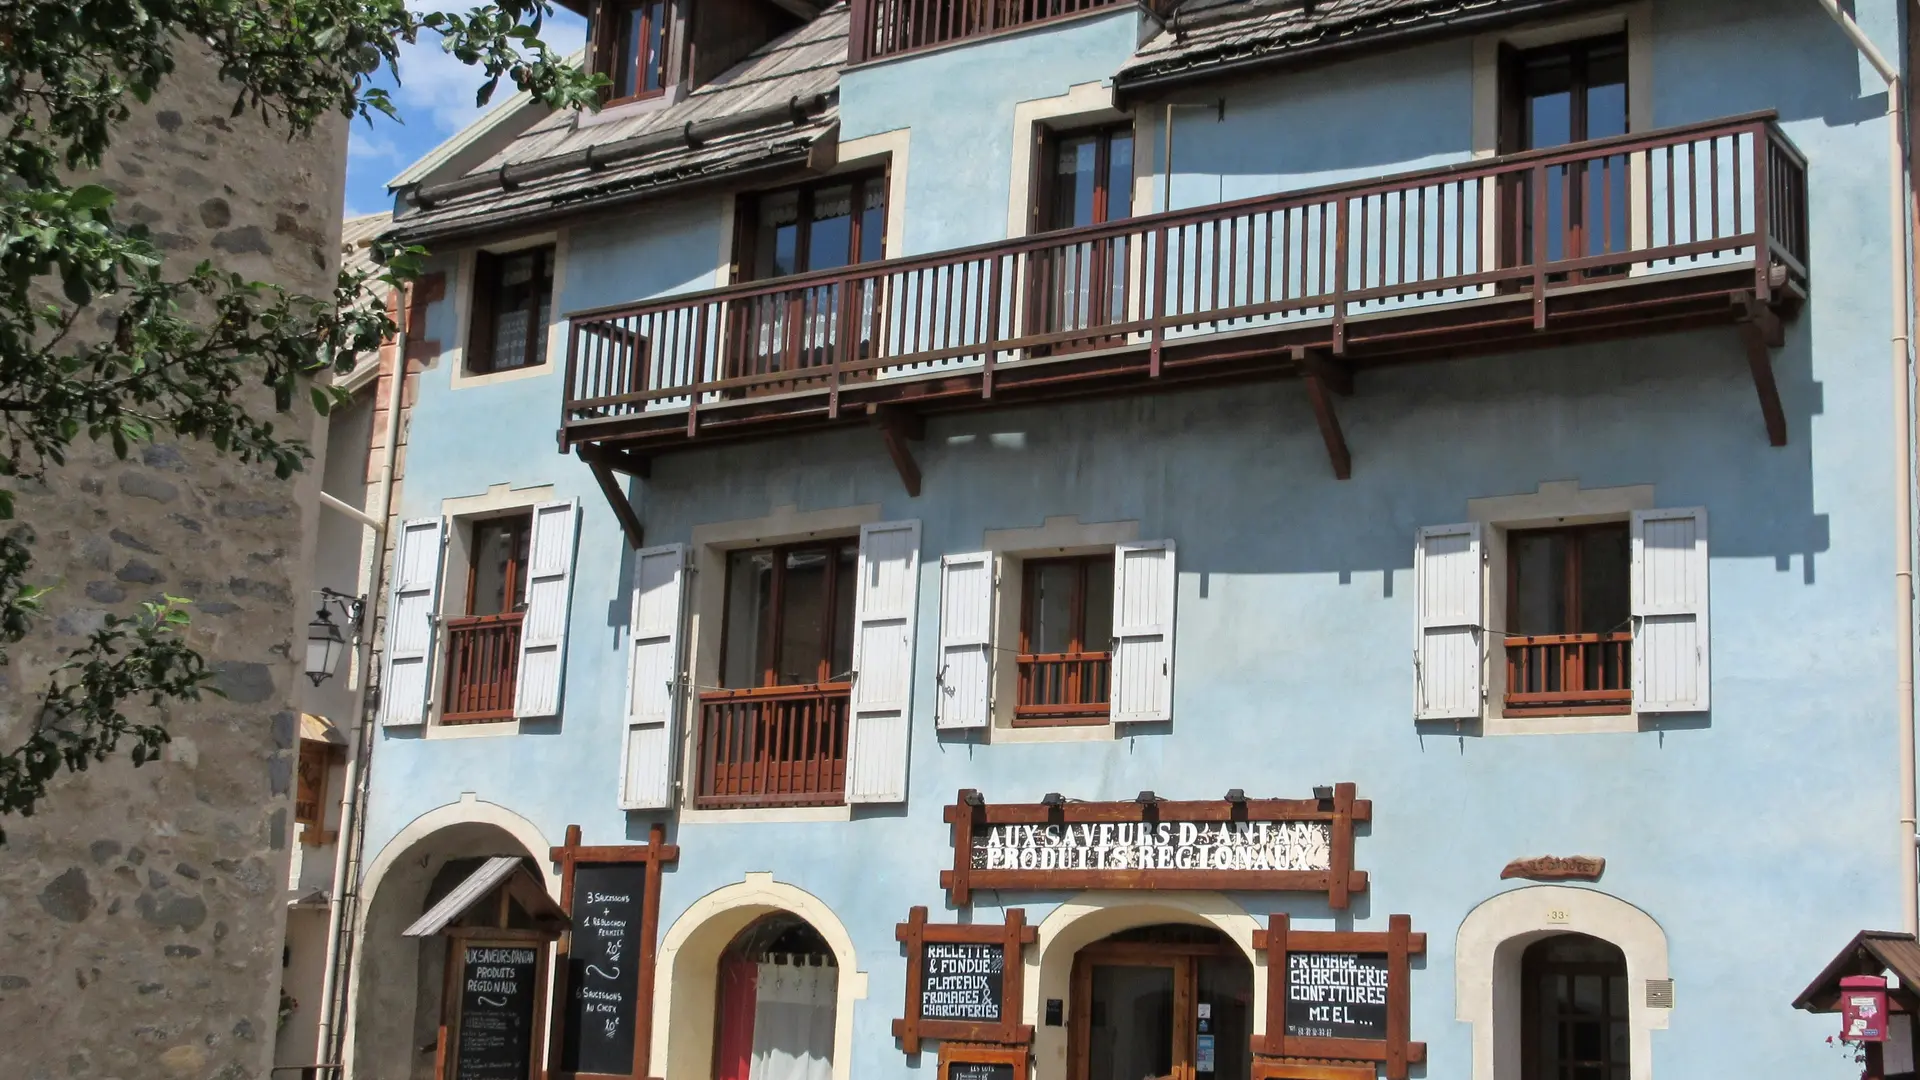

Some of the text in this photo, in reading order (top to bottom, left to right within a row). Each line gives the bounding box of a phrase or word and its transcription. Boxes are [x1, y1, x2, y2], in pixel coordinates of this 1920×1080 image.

[987, 824, 1038, 848] AUX
[1044, 822, 1171, 848] SAVEURS
[986, 845, 1312, 870] PRODUITS REGIONAUX
[586, 892, 593, 904] 3
[584, 916, 590, 927] 1
[477, 967, 515, 979] PRODUITS
[929, 959, 938, 973] &
[928, 976, 989, 990] PLATEAUX
[1290, 969, 1388, 987] CHARCUTERIE
[583, 987, 622, 1001] SAUCISSONS
[923, 988, 992, 1005] FROMAGES &
[1290, 985, 1385, 1004] CONFITURES
[586, 1003, 617, 1013] AU CHOIX
[923, 1004, 998, 1018] CHARCUTERIES
